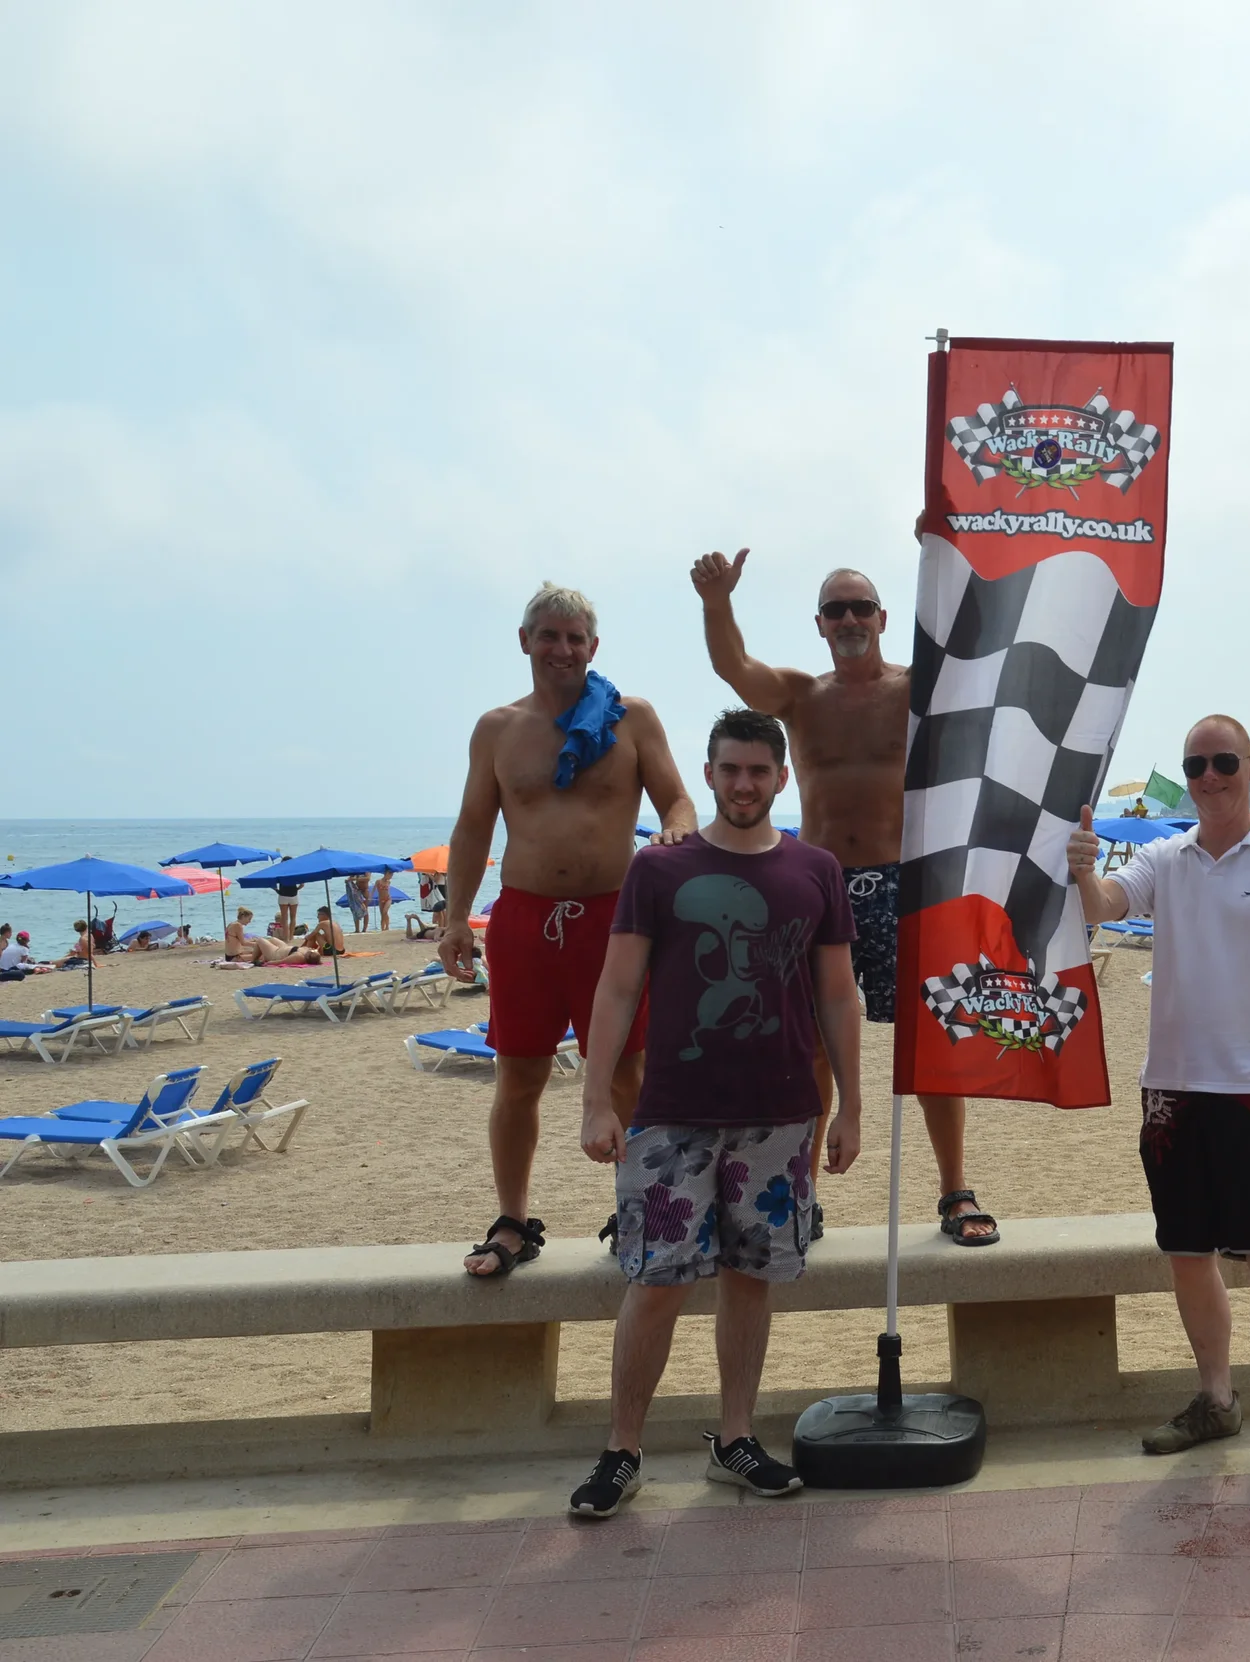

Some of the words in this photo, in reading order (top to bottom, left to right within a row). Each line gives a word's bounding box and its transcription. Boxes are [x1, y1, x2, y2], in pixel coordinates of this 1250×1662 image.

[985, 431, 1053, 455] Wack
[1057, 431, 1120, 463] Rally
[946, 510, 1153, 541] wackyrally.co.uk
[960, 993, 1022, 1014] Wacky
[1021, 995, 1051, 1027] Ray
